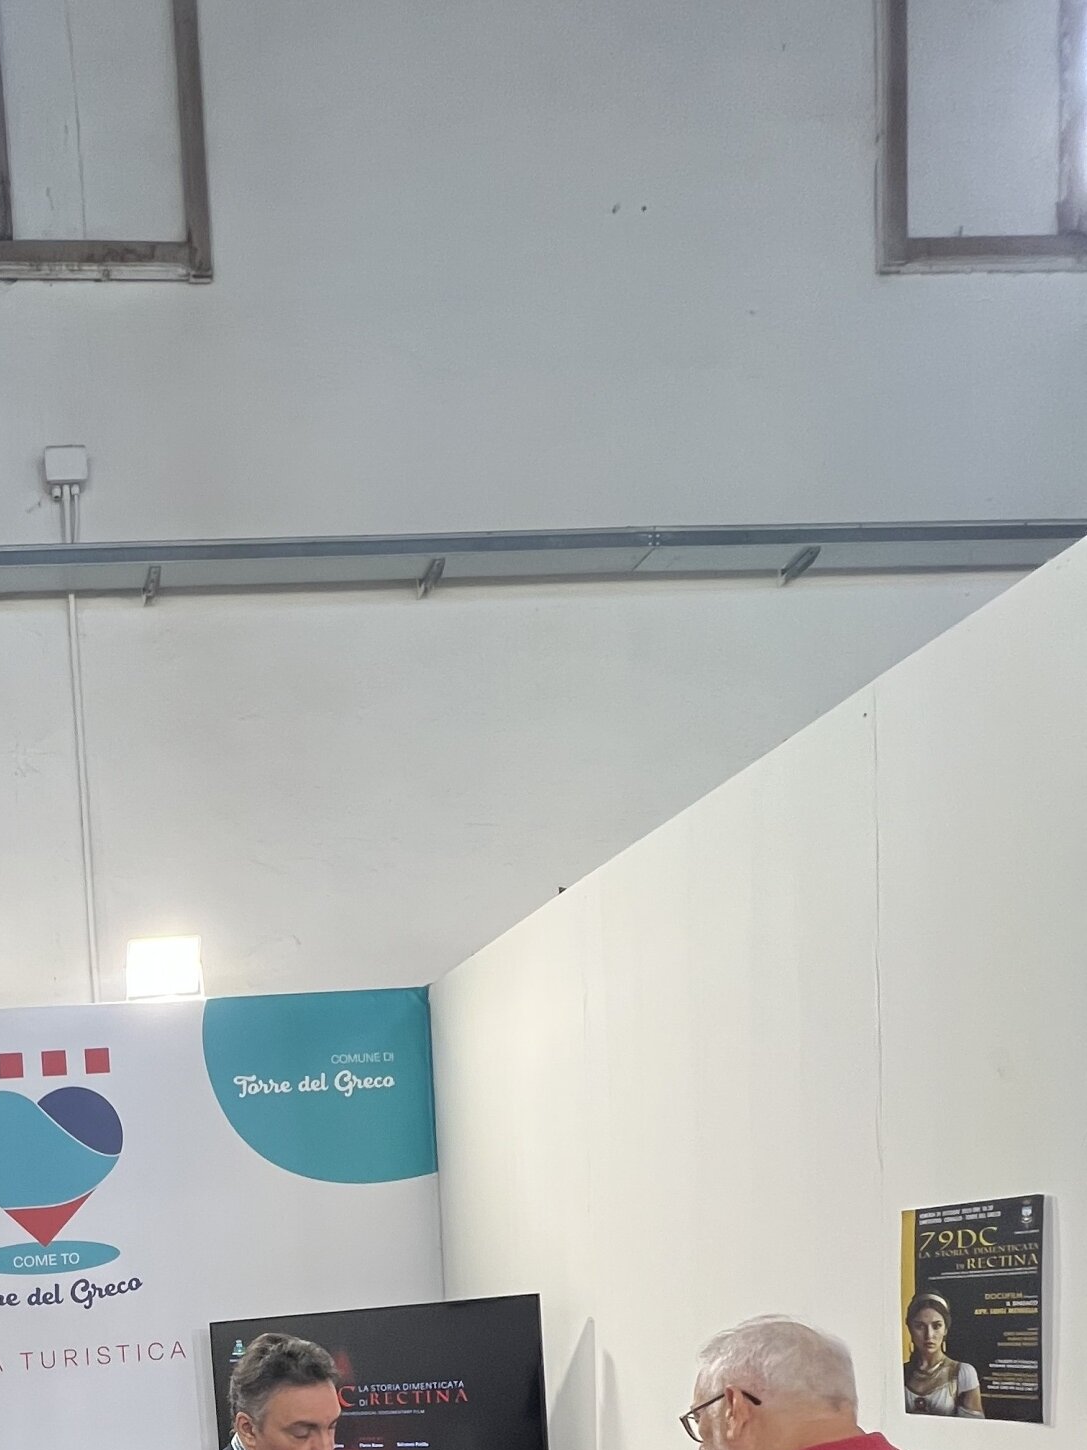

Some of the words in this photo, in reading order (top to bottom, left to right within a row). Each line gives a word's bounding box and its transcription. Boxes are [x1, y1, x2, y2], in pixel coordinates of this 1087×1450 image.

[331, 1052, 380, 1064] COMUNE
[383, 1052, 394, 1062] DI
[233, 1074, 293, 1098] Torre
[298, 1072, 329, 1093] del
[333, 1069, 395, 1097] Greco
[920, 1226, 998, 1252] 79DC
[935, 1248, 969, 1258] STORIA
[974, 1242, 1039, 1254] DIMENTICATA
[13, 1253, 57, 1269] COME
[60, 1252, 80, 1265] TO
[967, 1253, 1039, 1270] RECTINA
[27, 1283, 64, 1306] del
[70, 1277, 143, 1310] Greco
[19, 1340, 187, 1370] TURISTICA
[338, 1385, 355, 1407] C
[358, 1385, 369, 1393] LA
[370, 1384, 401, 1392] STORIA
[403, 1380, 465, 1391] DIMENTICATA
[369, 1388, 468, 1406] RECTINA
